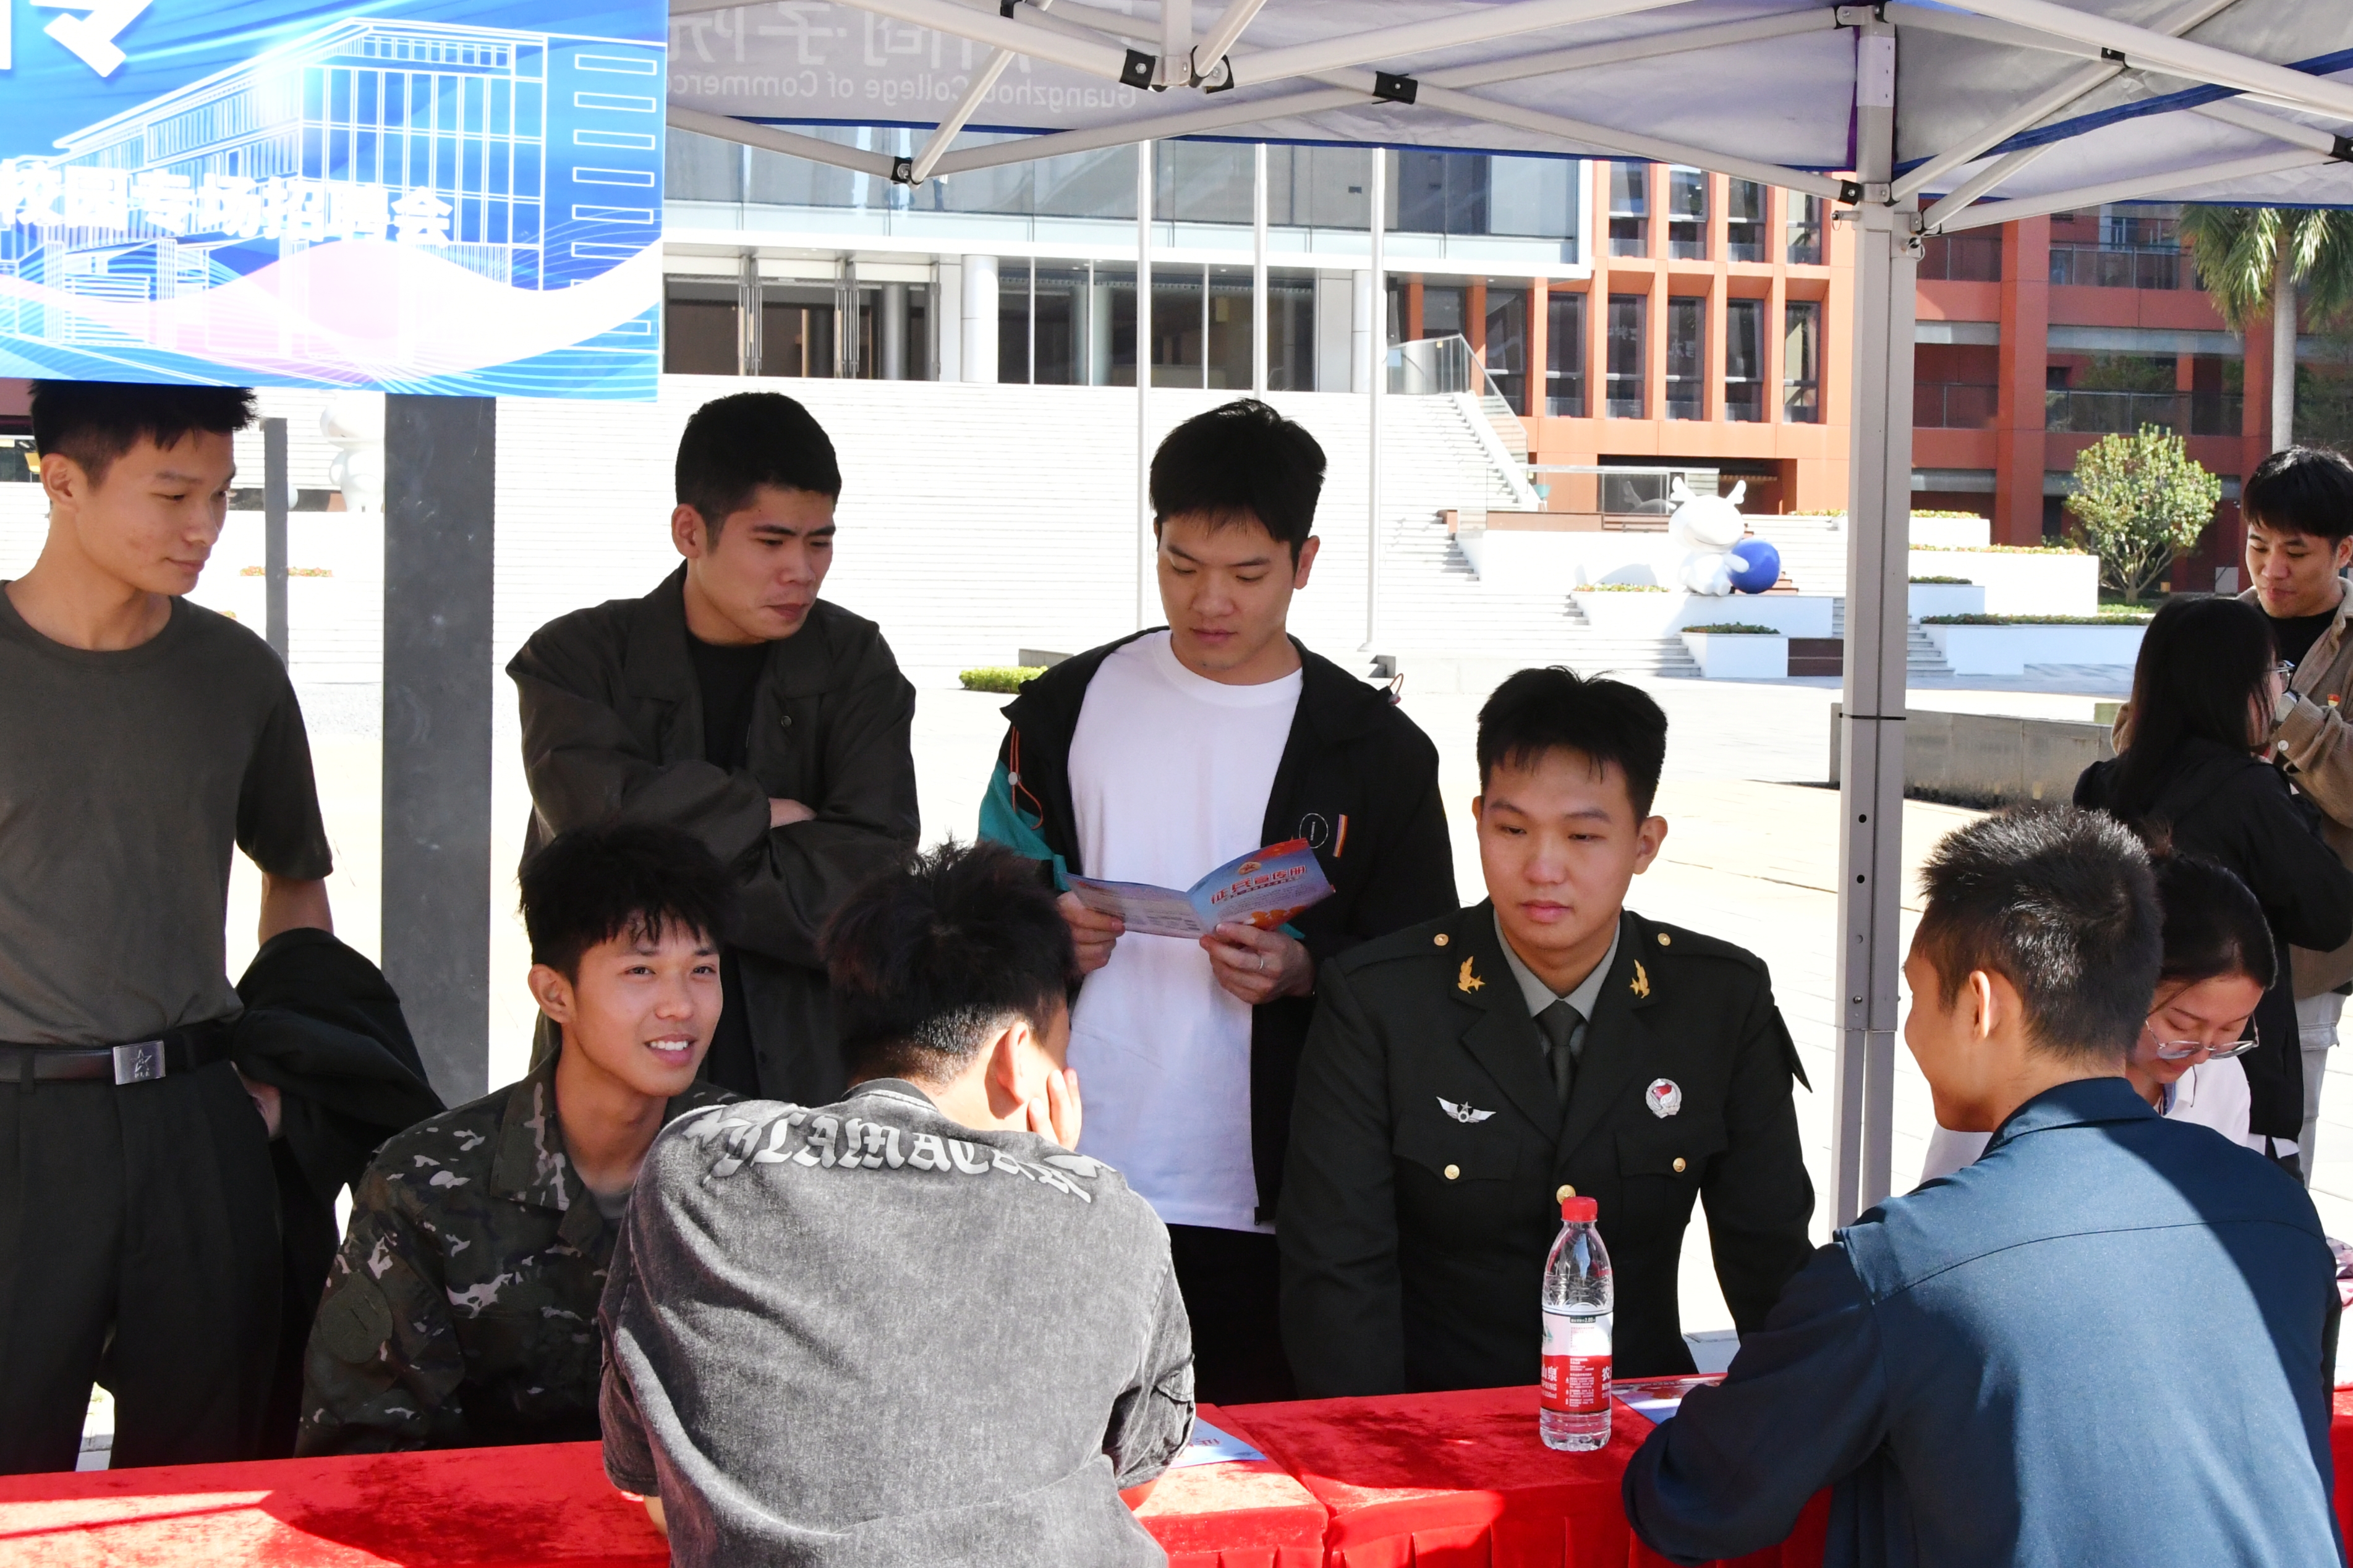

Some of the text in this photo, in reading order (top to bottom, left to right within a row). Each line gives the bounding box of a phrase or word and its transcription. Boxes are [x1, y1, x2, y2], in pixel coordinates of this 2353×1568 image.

[0, 158, 453, 248] 校园专场招聘会
[1210, 865, 1307, 905] 征兵宣传册
